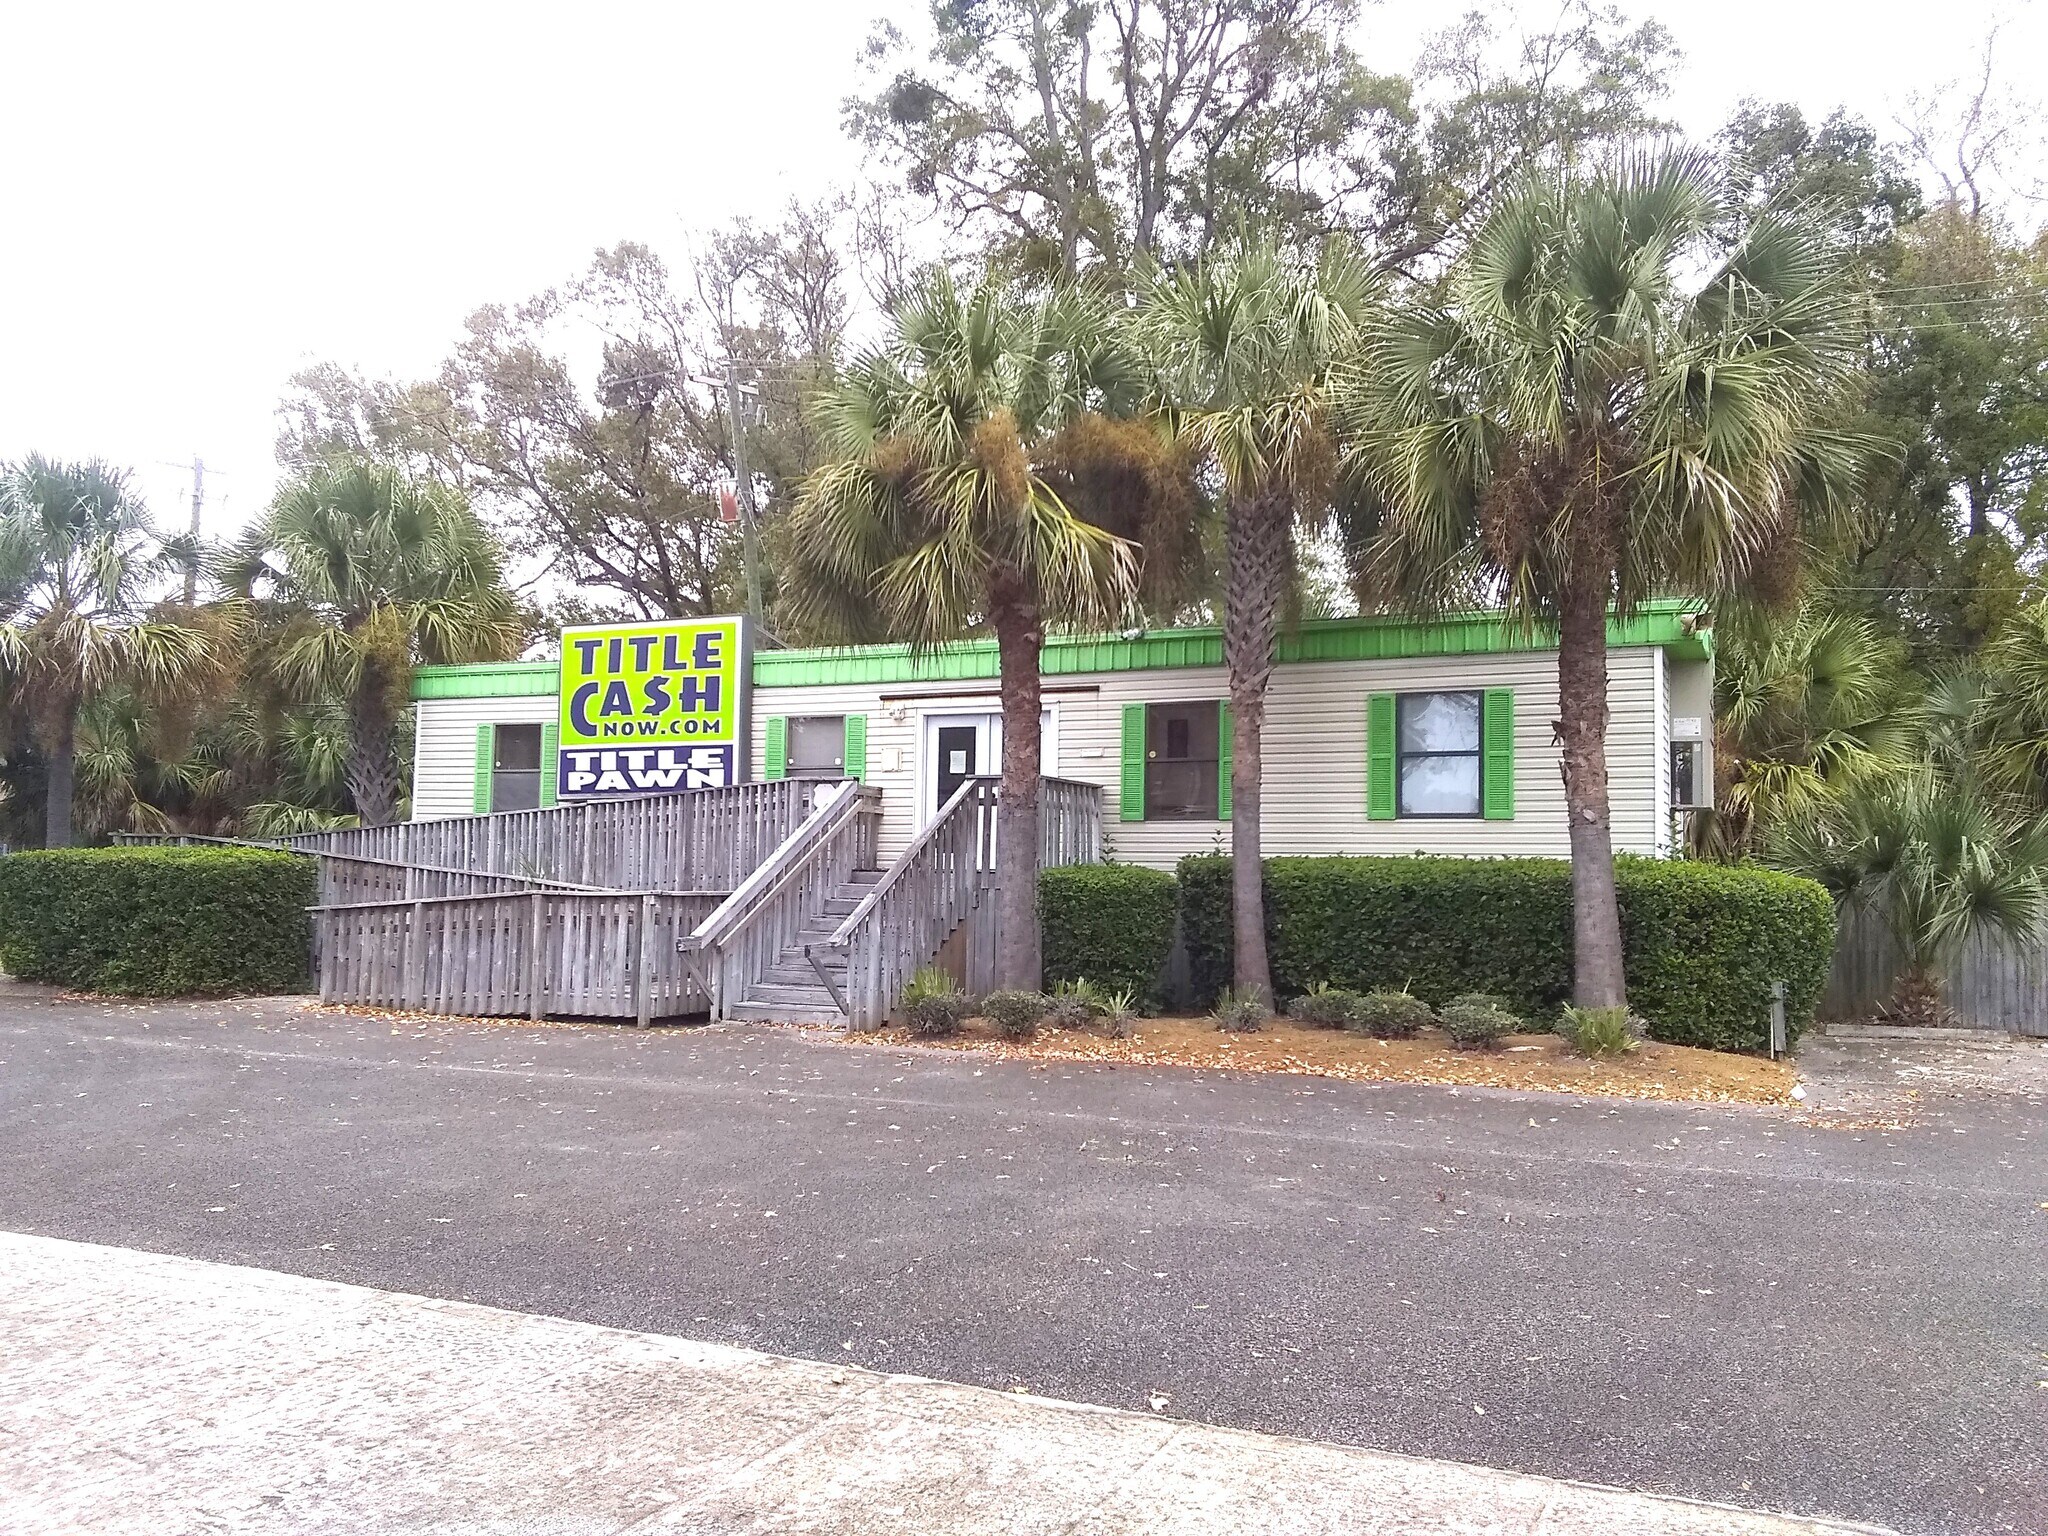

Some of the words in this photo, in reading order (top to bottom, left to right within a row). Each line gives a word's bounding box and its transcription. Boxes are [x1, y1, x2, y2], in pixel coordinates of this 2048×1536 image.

[574, 632, 723, 675] TITLE
[603, 719, 720, 736] NOW.COM
[566, 748, 725, 771] TITLE
[567, 769, 725, 790] PAWN
